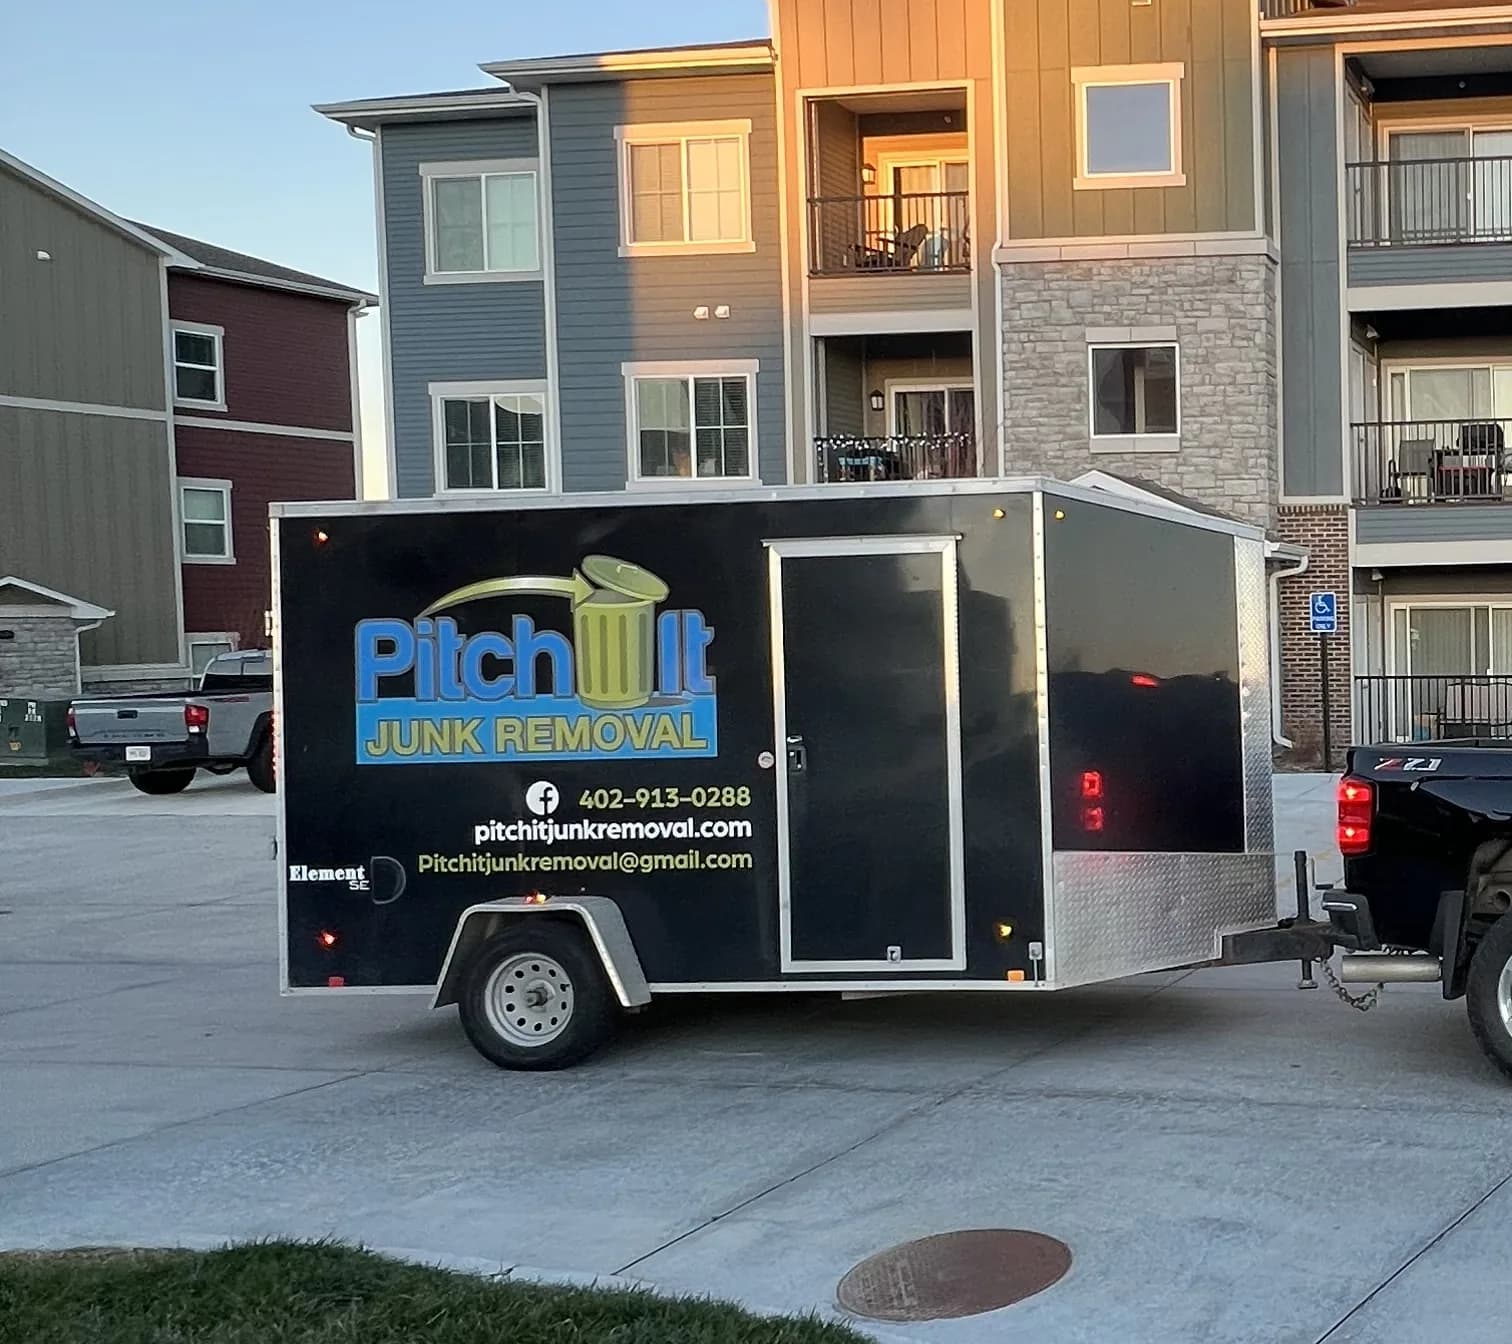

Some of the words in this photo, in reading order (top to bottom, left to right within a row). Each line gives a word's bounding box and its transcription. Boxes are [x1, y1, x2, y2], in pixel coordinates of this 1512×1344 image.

[355, 613, 576, 704] Pitch
[657, 608, 717, 698] It
[365, 717, 485, 758] JUNK
[495, 712, 708, 755] REMOVAL
[579, 786, 752, 810] 402-913-0288
[474, 816, 753, 845] pitchitjunkremoval.com
[288, 864, 366, 881] Element
[417, 848, 753, 876] Pitchitjunkremoval@gmail.com
[348, 879, 371, 891] SE
